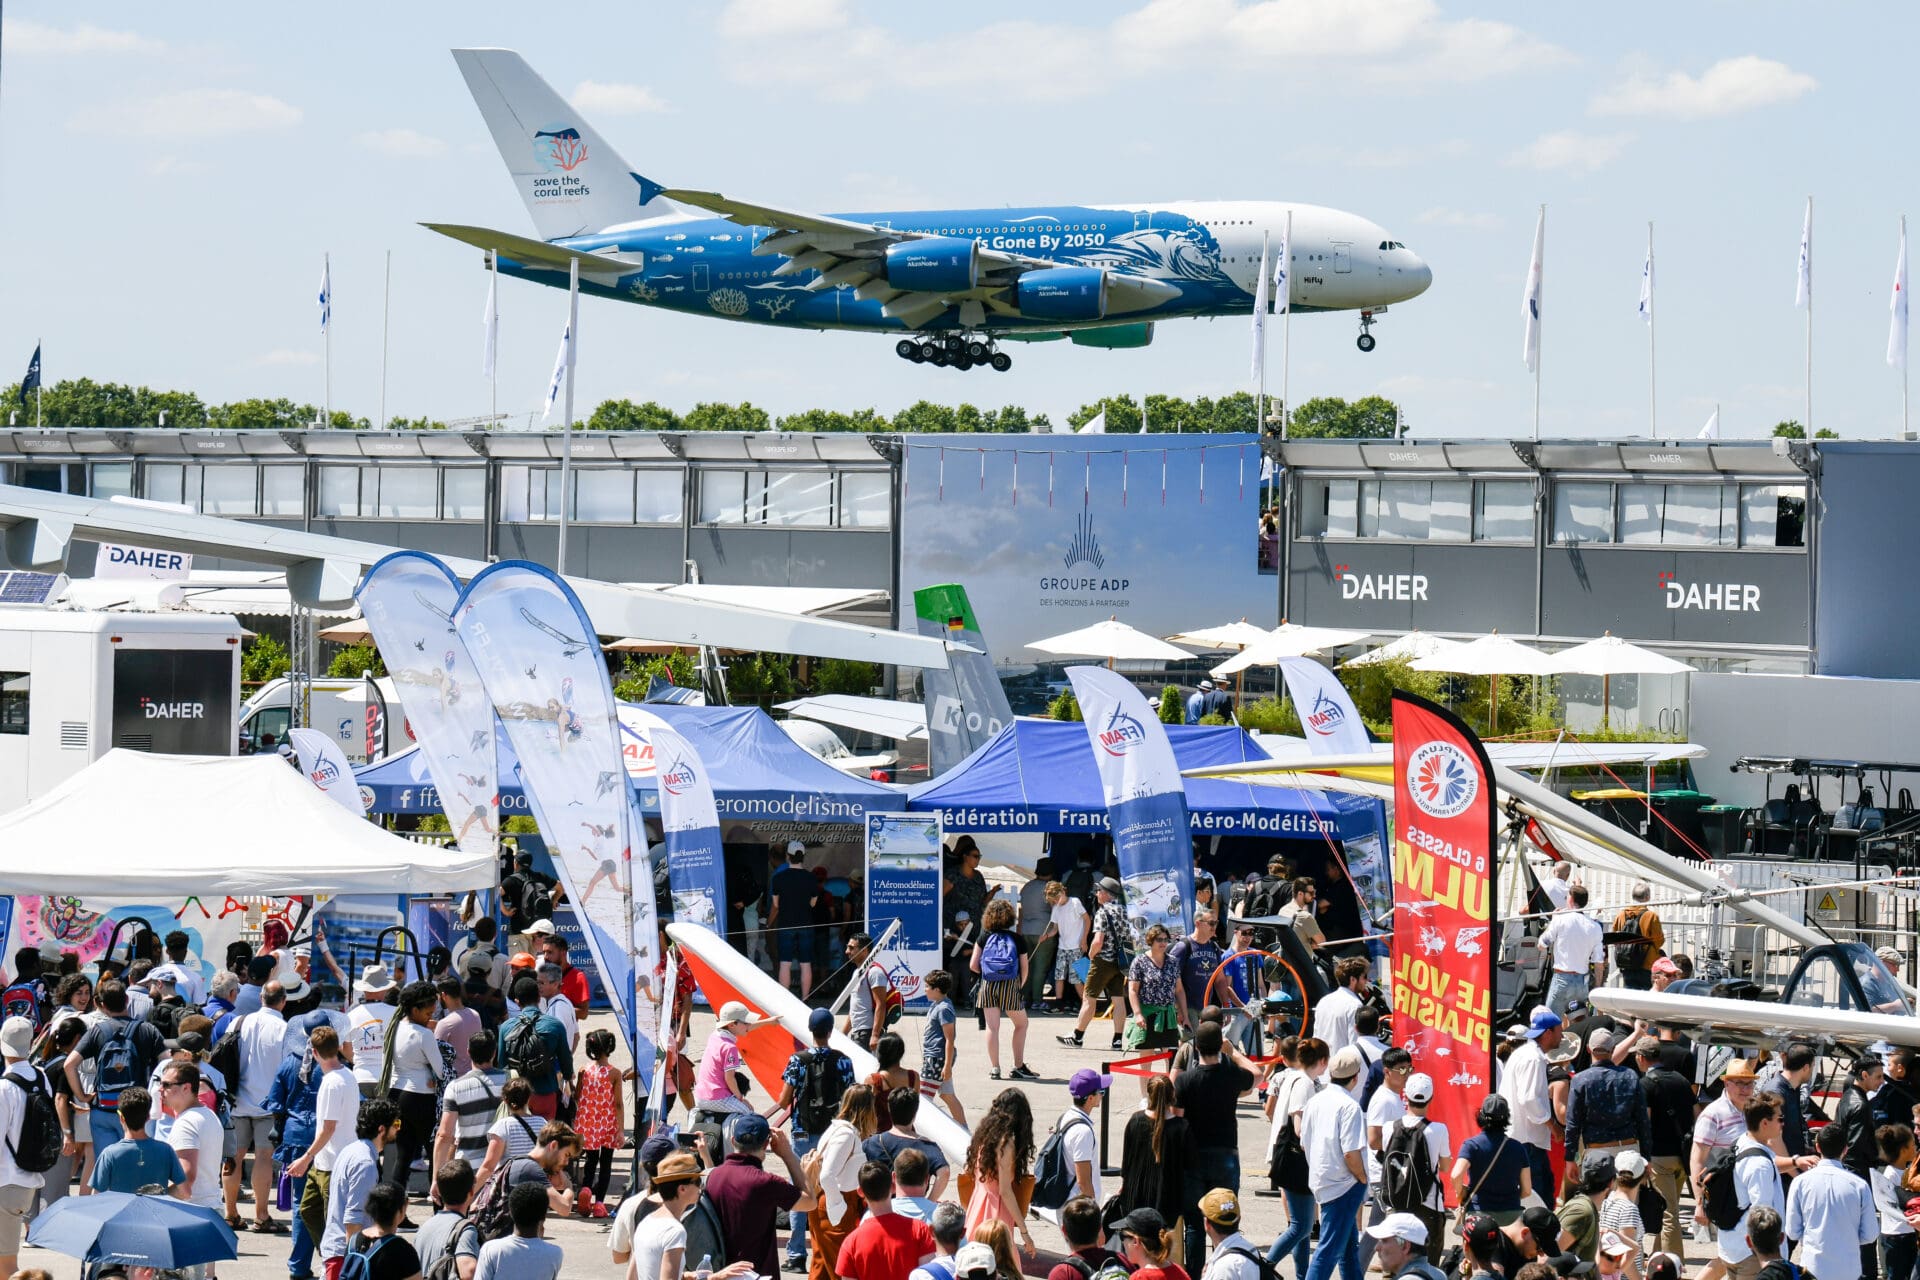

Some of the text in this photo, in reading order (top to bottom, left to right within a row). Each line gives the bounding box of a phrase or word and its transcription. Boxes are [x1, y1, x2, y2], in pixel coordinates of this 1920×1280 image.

[533, 175, 580, 187] save the
[534, 185, 590, 197] coral reefs
[977, 233, 1105, 250] fs Gone By 2050
[1389, 452, 1420, 462] DAHER
[1649, 453, 1682, 463] DAHER
[109, 546, 183, 571] DAHER
[1040, 577, 1130, 591] GROUPE ADP
[1342, 573, 1429, 601] DAHER
[1040, 598, 1053, 606] DES
[1054, 599, 1088, 607] HORIZONS
[1096, 599, 1130, 607] PARTAGER
[1666, 581, 1761, 612] DAHER
[145, 702, 204, 719] DAHER
[944, 706, 1002, 737] KOD
[340, 731, 351, 739] 15
[714, 794, 863, 817] eromodelisme
[751, 821, 812, 832] Fédération
[1059, 809, 1111, 830] Franç
[1187, 810, 1340, 834] 'Aéro-Modélism
[770, 832, 865, 844] d'AéroModélism
[873, 880, 936, 889] l'Aéromodélisme
[882, 890, 897, 898] pieds
[891, 976, 919, 986] FFAM
